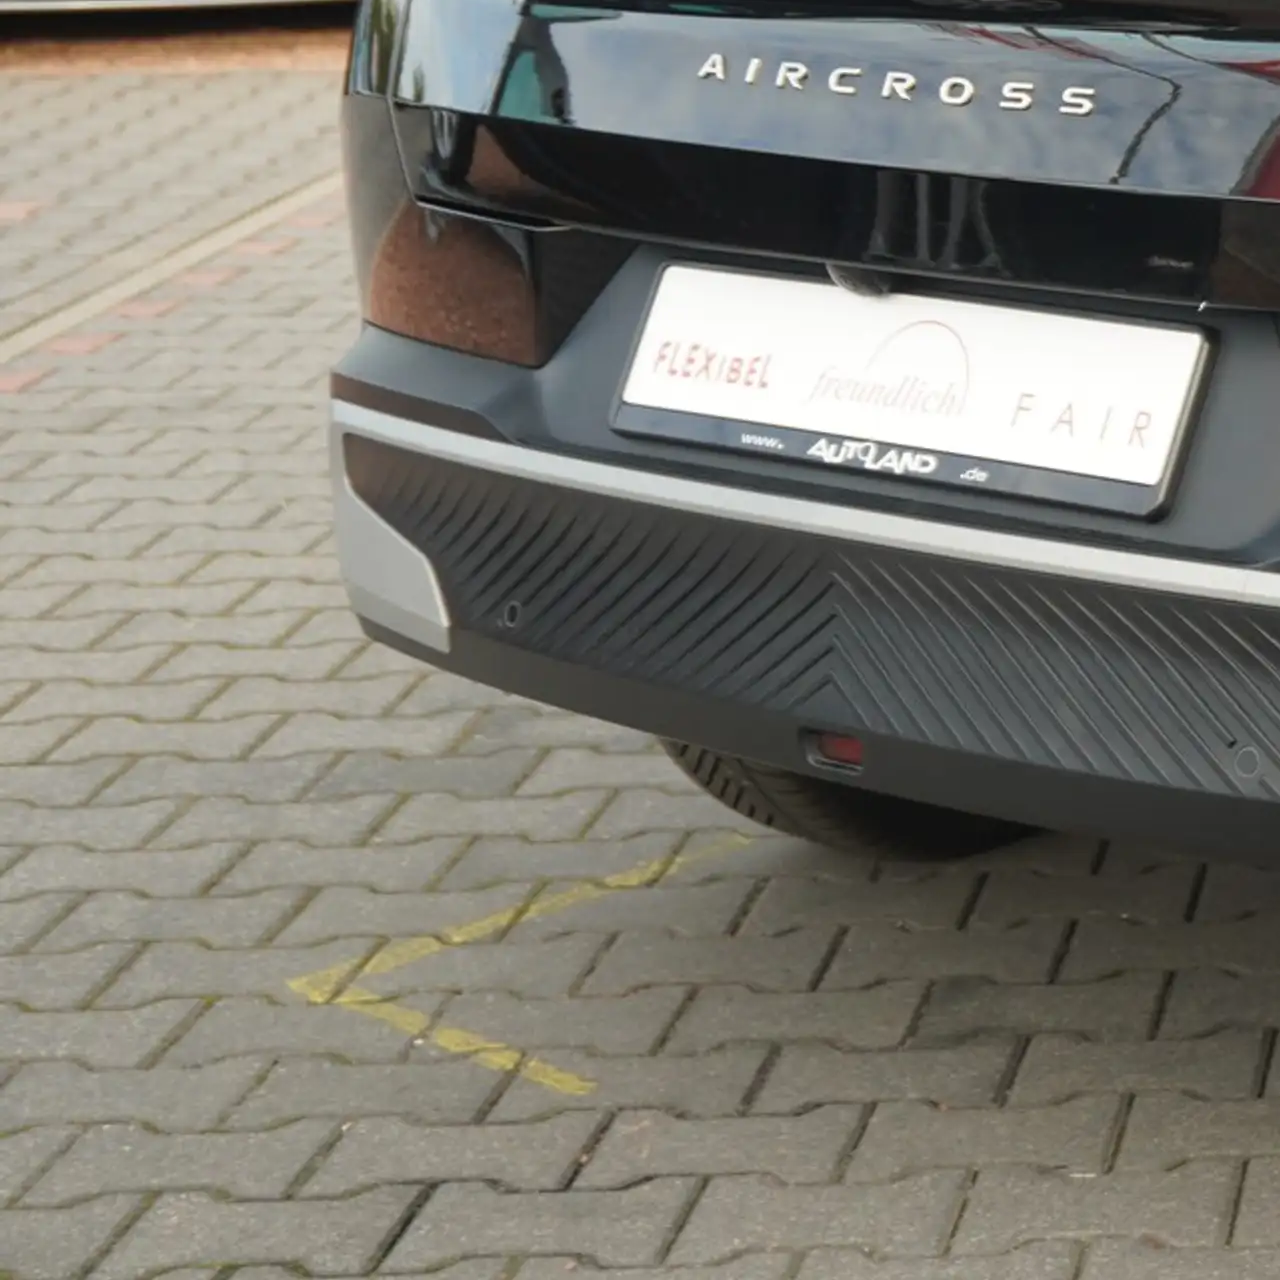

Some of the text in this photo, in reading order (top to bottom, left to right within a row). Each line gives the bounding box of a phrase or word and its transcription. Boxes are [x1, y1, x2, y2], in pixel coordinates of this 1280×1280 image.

[696, 52, 1097, 117] AIRCROSS
[653, 340, 774, 389] FLEXIBEL
[1010, 392, 1152, 448] FAIR
[741, 432, 990, 483] www. AUTOLAND .de
